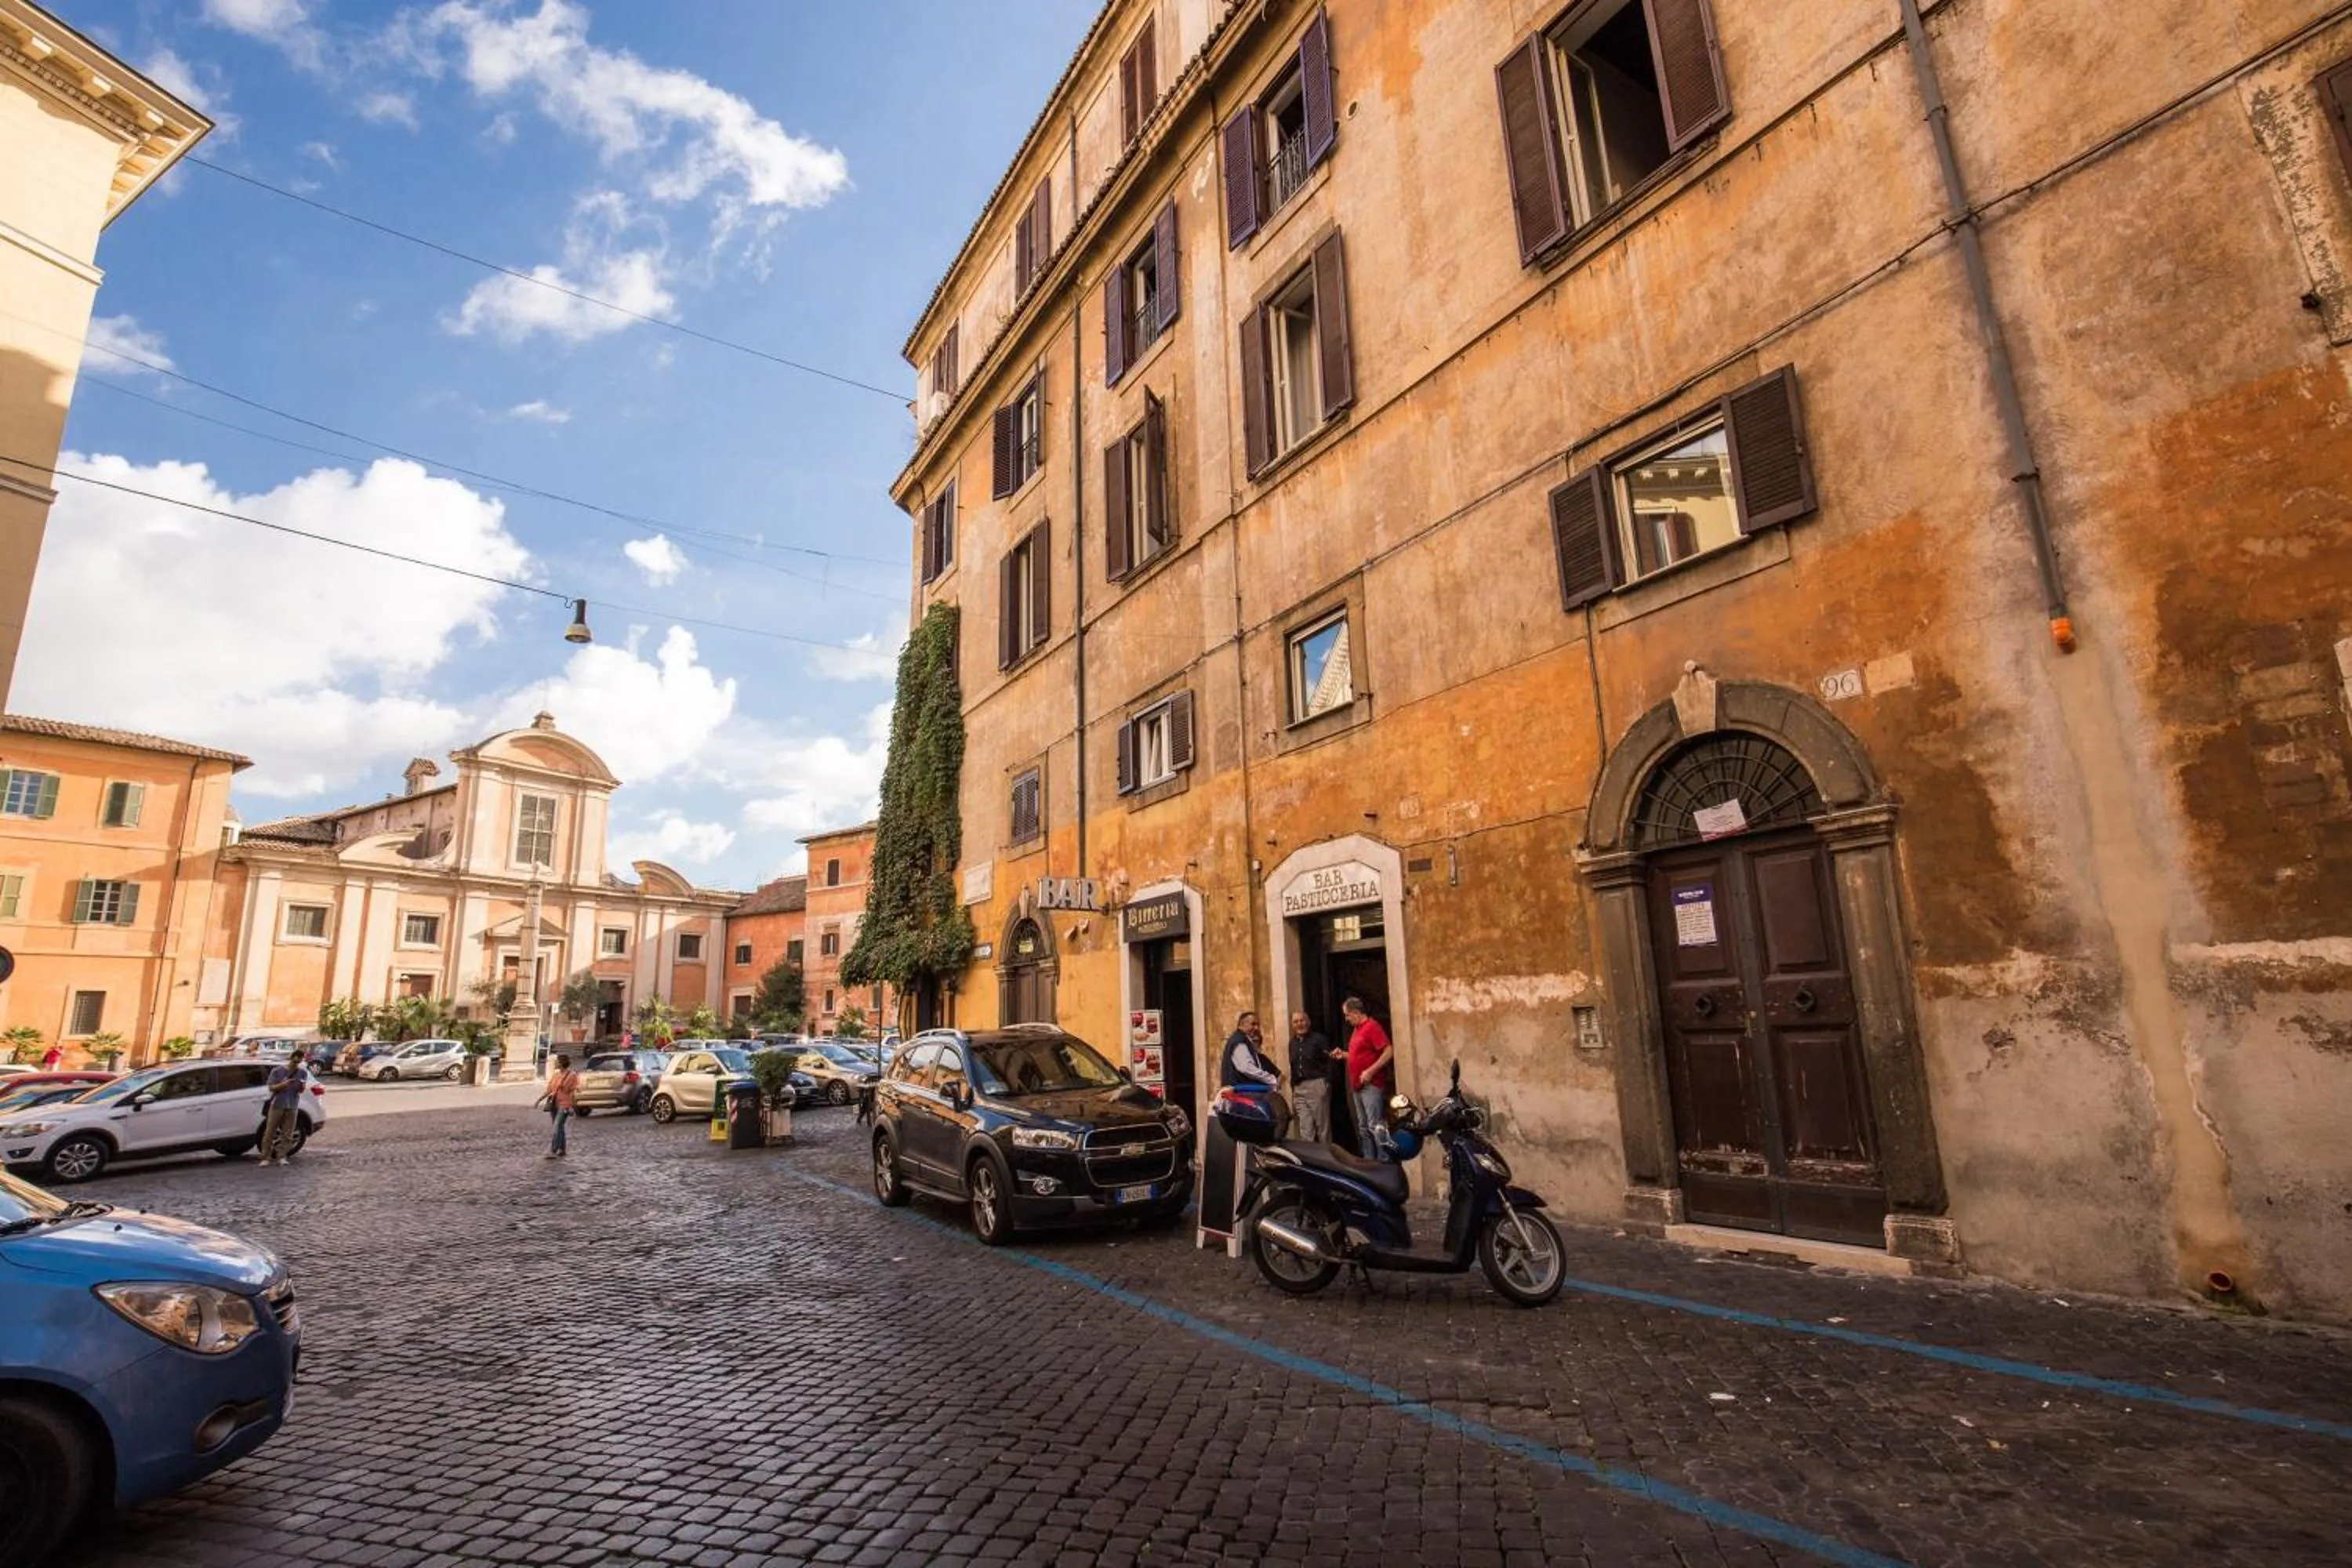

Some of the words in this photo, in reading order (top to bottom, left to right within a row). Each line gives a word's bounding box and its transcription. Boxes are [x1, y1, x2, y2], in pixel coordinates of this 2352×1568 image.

[1825, 673, 1854, 697] 96
[1313, 869, 1344, 889] BAR
[1038, 877, 1098, 909] BAR
[1285, 880, 1379, 911] PASTICCERIA
